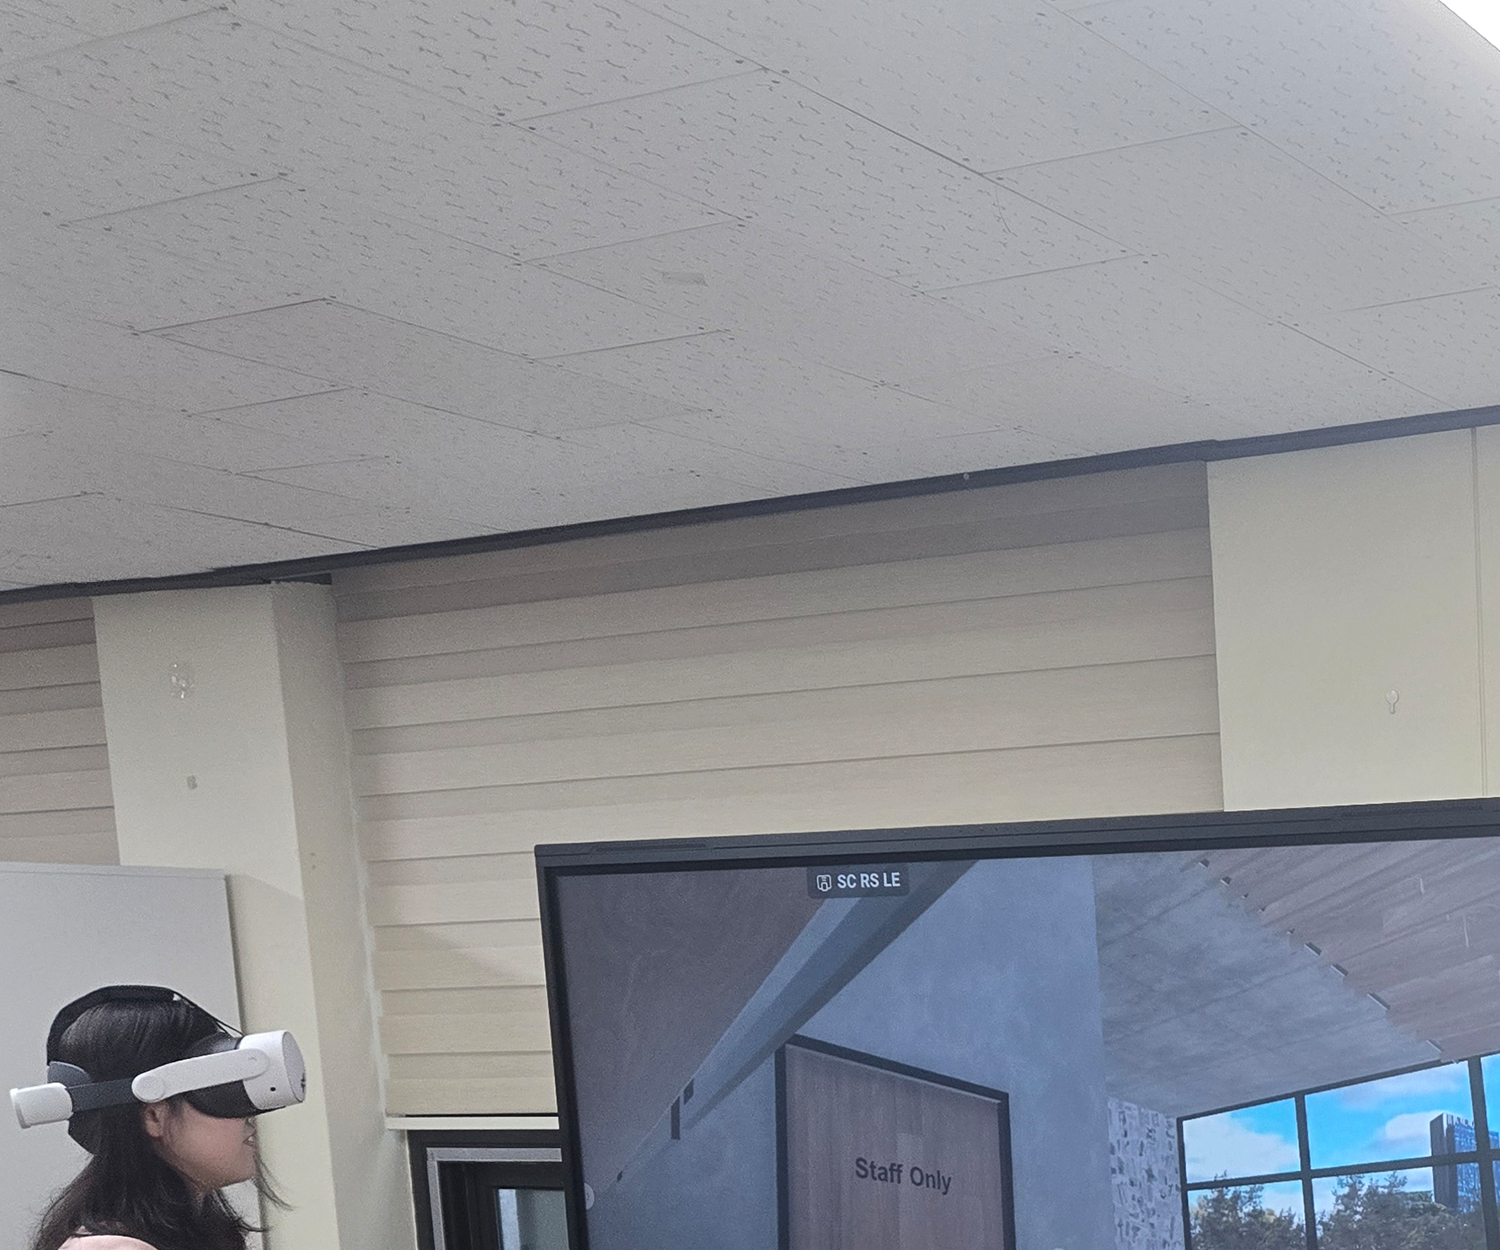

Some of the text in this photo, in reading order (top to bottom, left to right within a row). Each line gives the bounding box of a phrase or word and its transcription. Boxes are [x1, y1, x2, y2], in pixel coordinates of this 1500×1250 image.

[837, 872, 901, 889] SC RS LE
[855, 1157, 952, 1195] Staff Only
